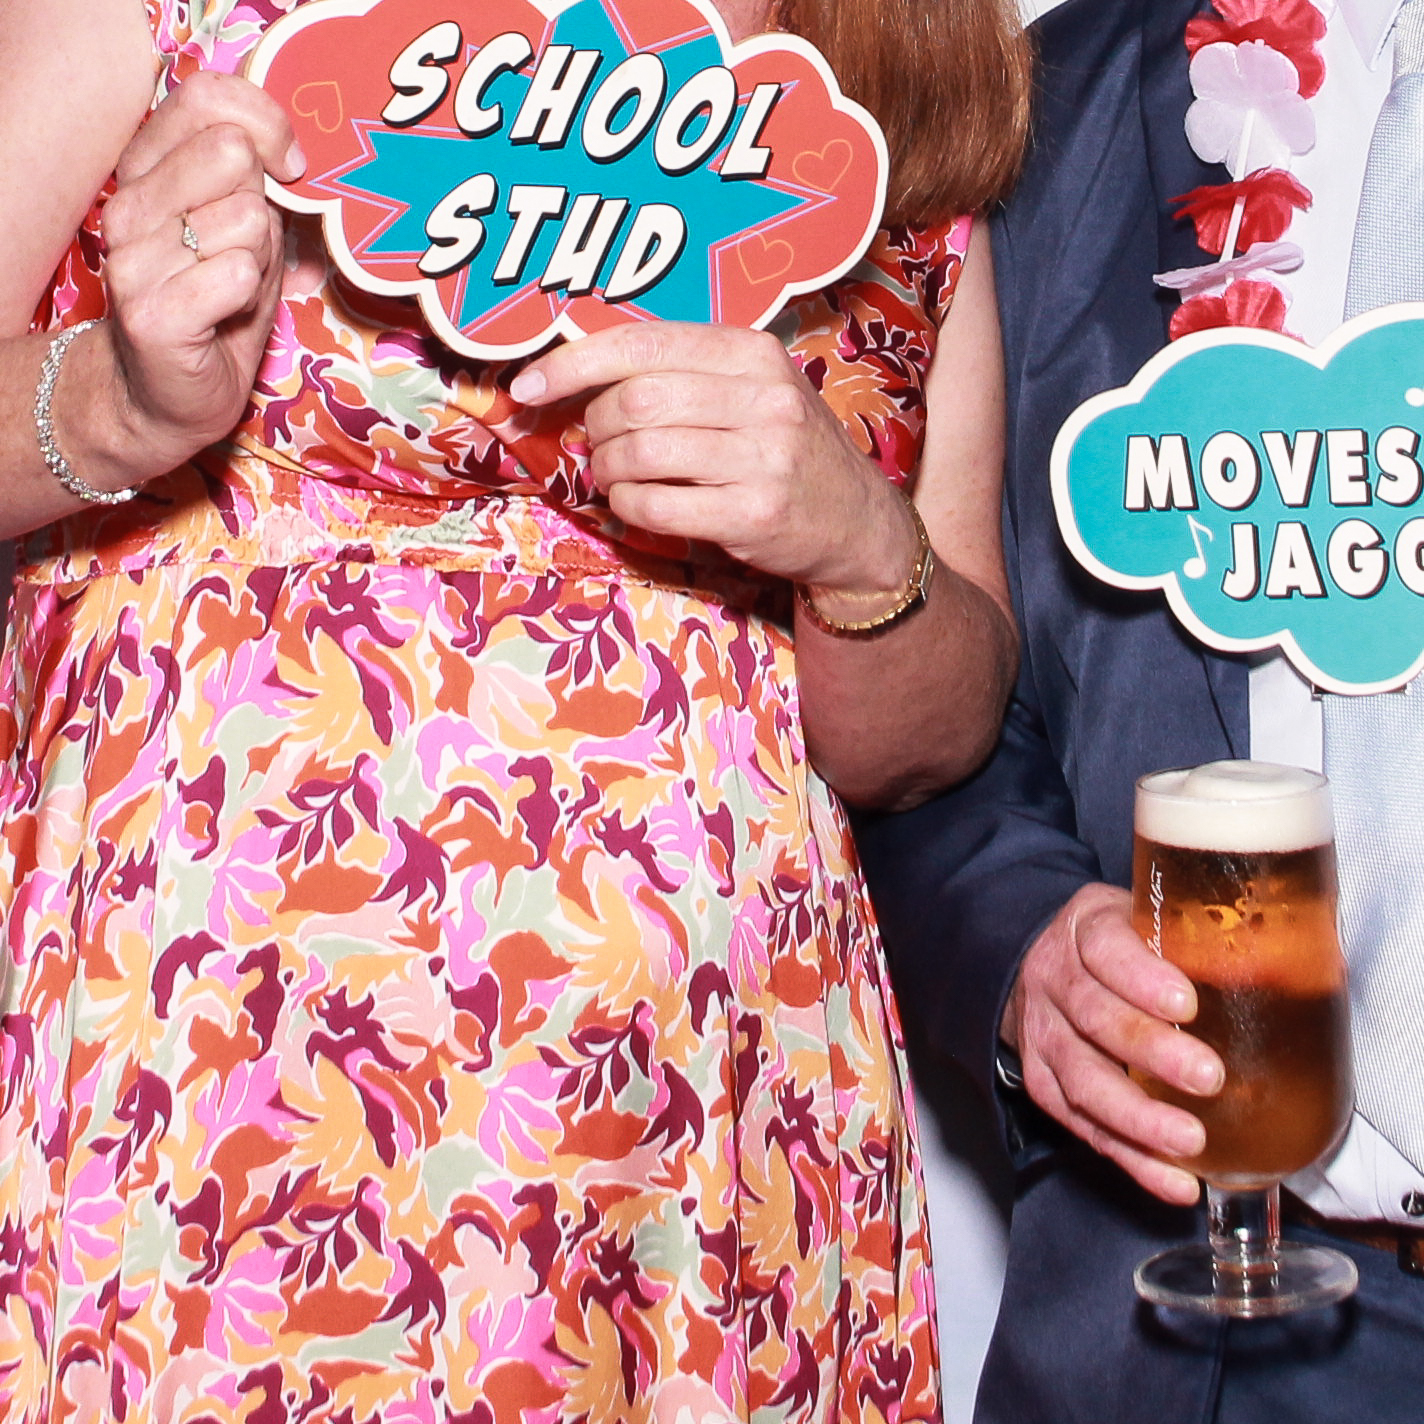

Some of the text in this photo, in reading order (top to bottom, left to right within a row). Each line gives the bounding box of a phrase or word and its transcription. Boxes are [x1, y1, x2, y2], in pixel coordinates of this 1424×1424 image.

[379, 20, 782, 182] SCHOOL
[416, 172, 688, 305] STUD
[1123, 424, 1424, 512] MOVES
